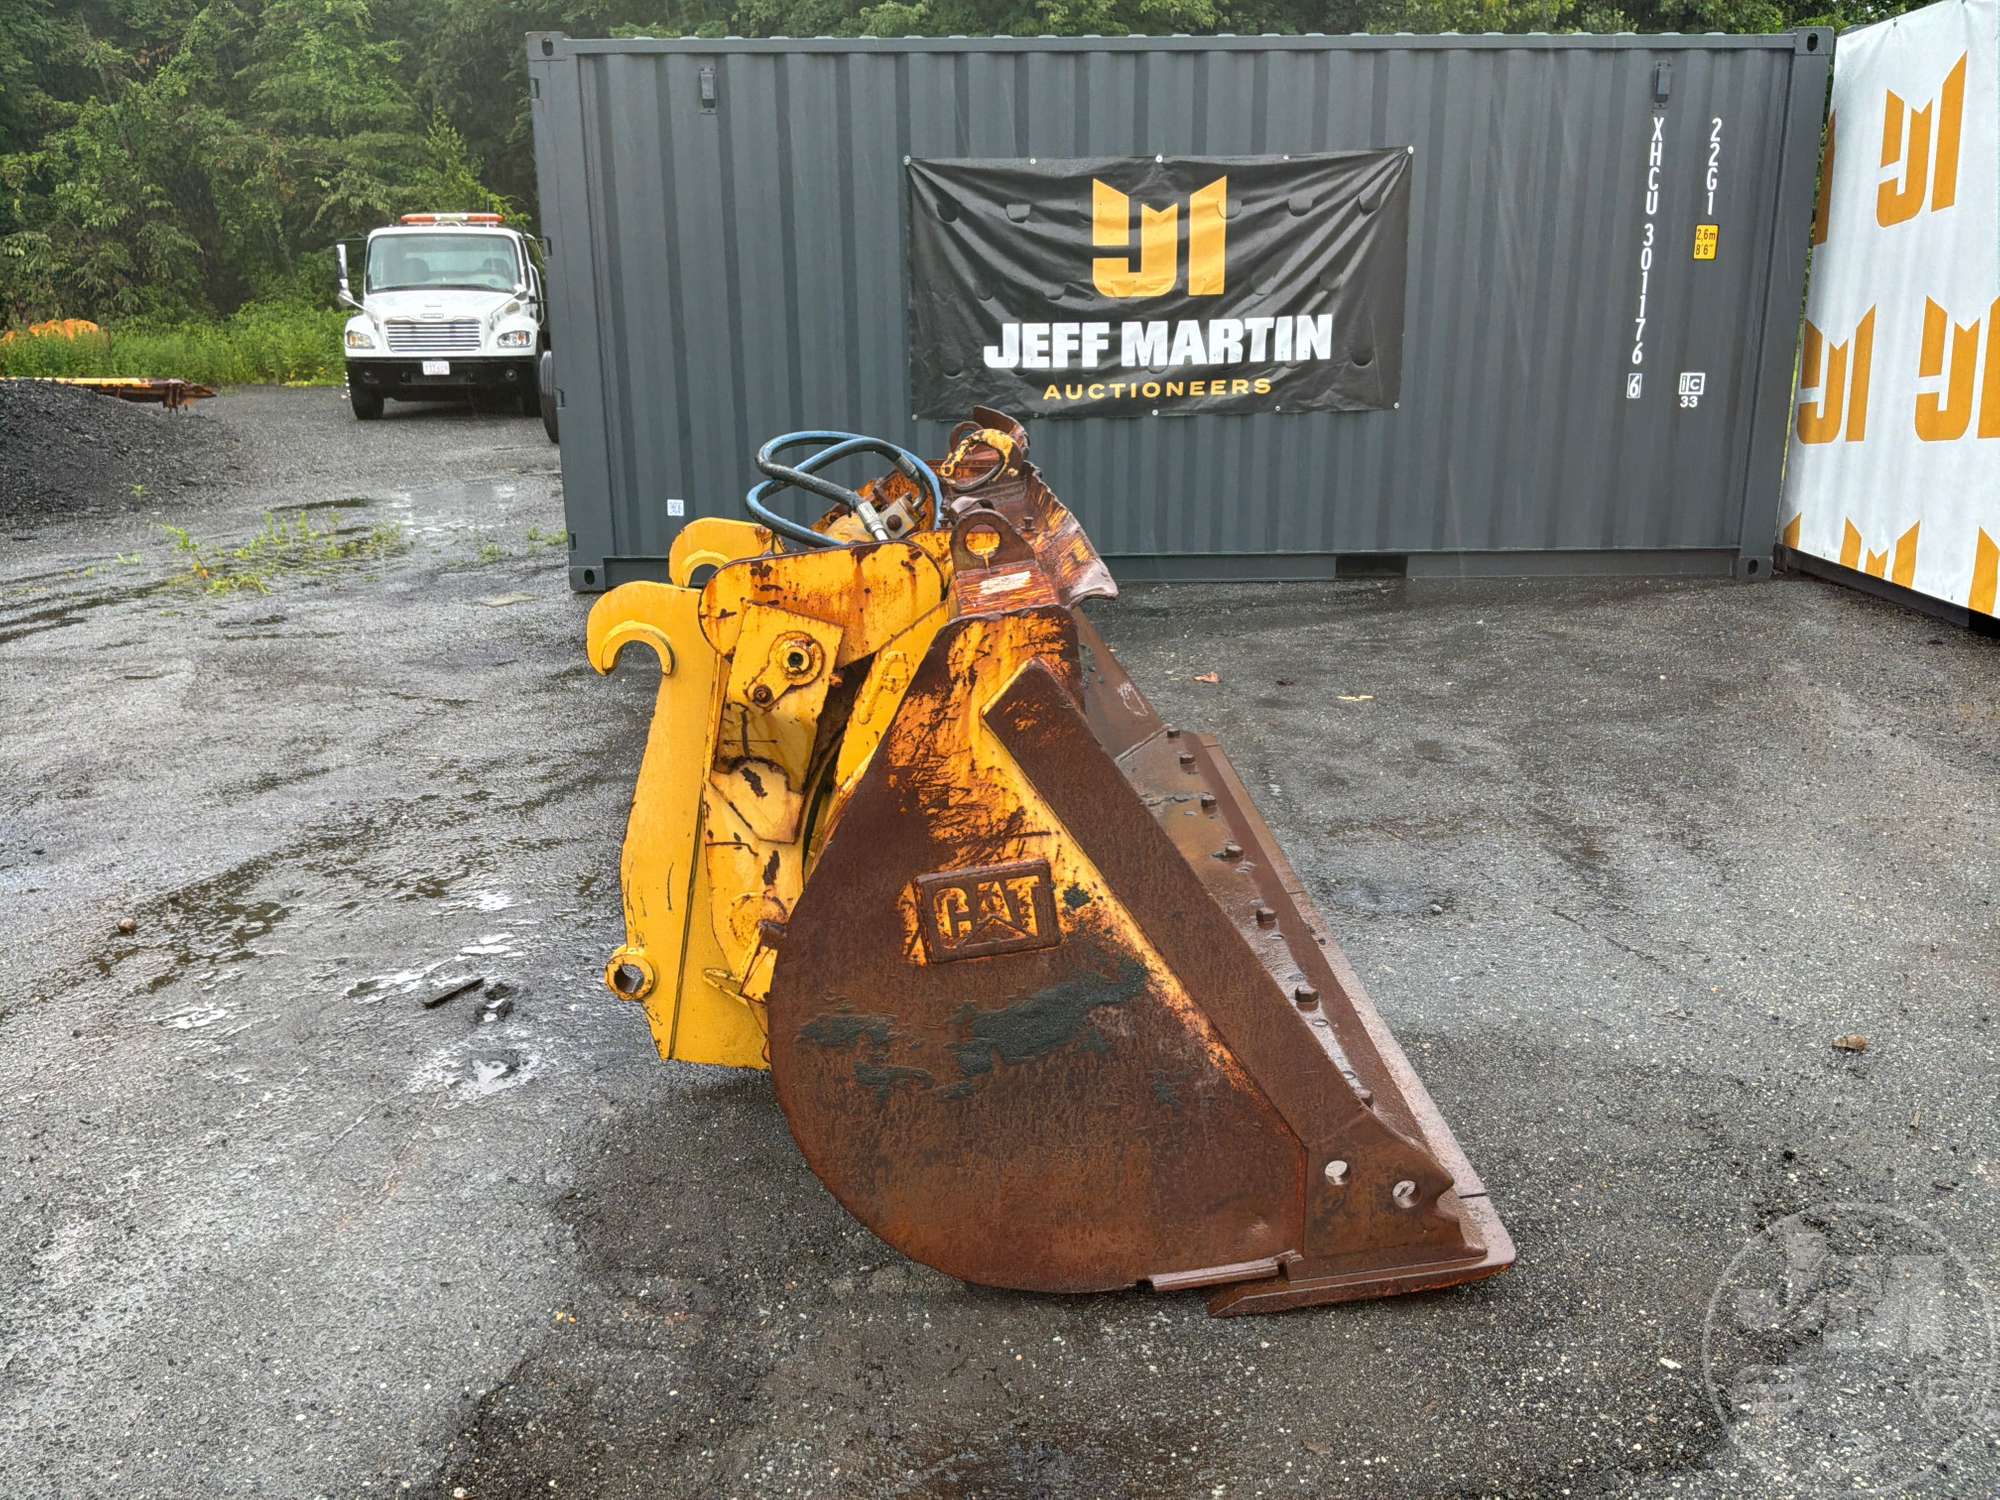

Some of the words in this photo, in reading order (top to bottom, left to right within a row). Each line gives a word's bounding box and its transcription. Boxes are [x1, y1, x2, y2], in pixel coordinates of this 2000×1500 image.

[1646, 117, 1664, 215] XHCU
[1706, 117, 1722, 215] 22G1
[1631, 223, 1654, 364] 301176
[983, 321, 1110, 369] JEFF
[1120, 314, 1334, 368] MARTIN
[1042, 377, 1273, 401] AUCTIONEERS
[1680, 396, 1698, 408] 33
[933, 874, 1040, 949] CAT
